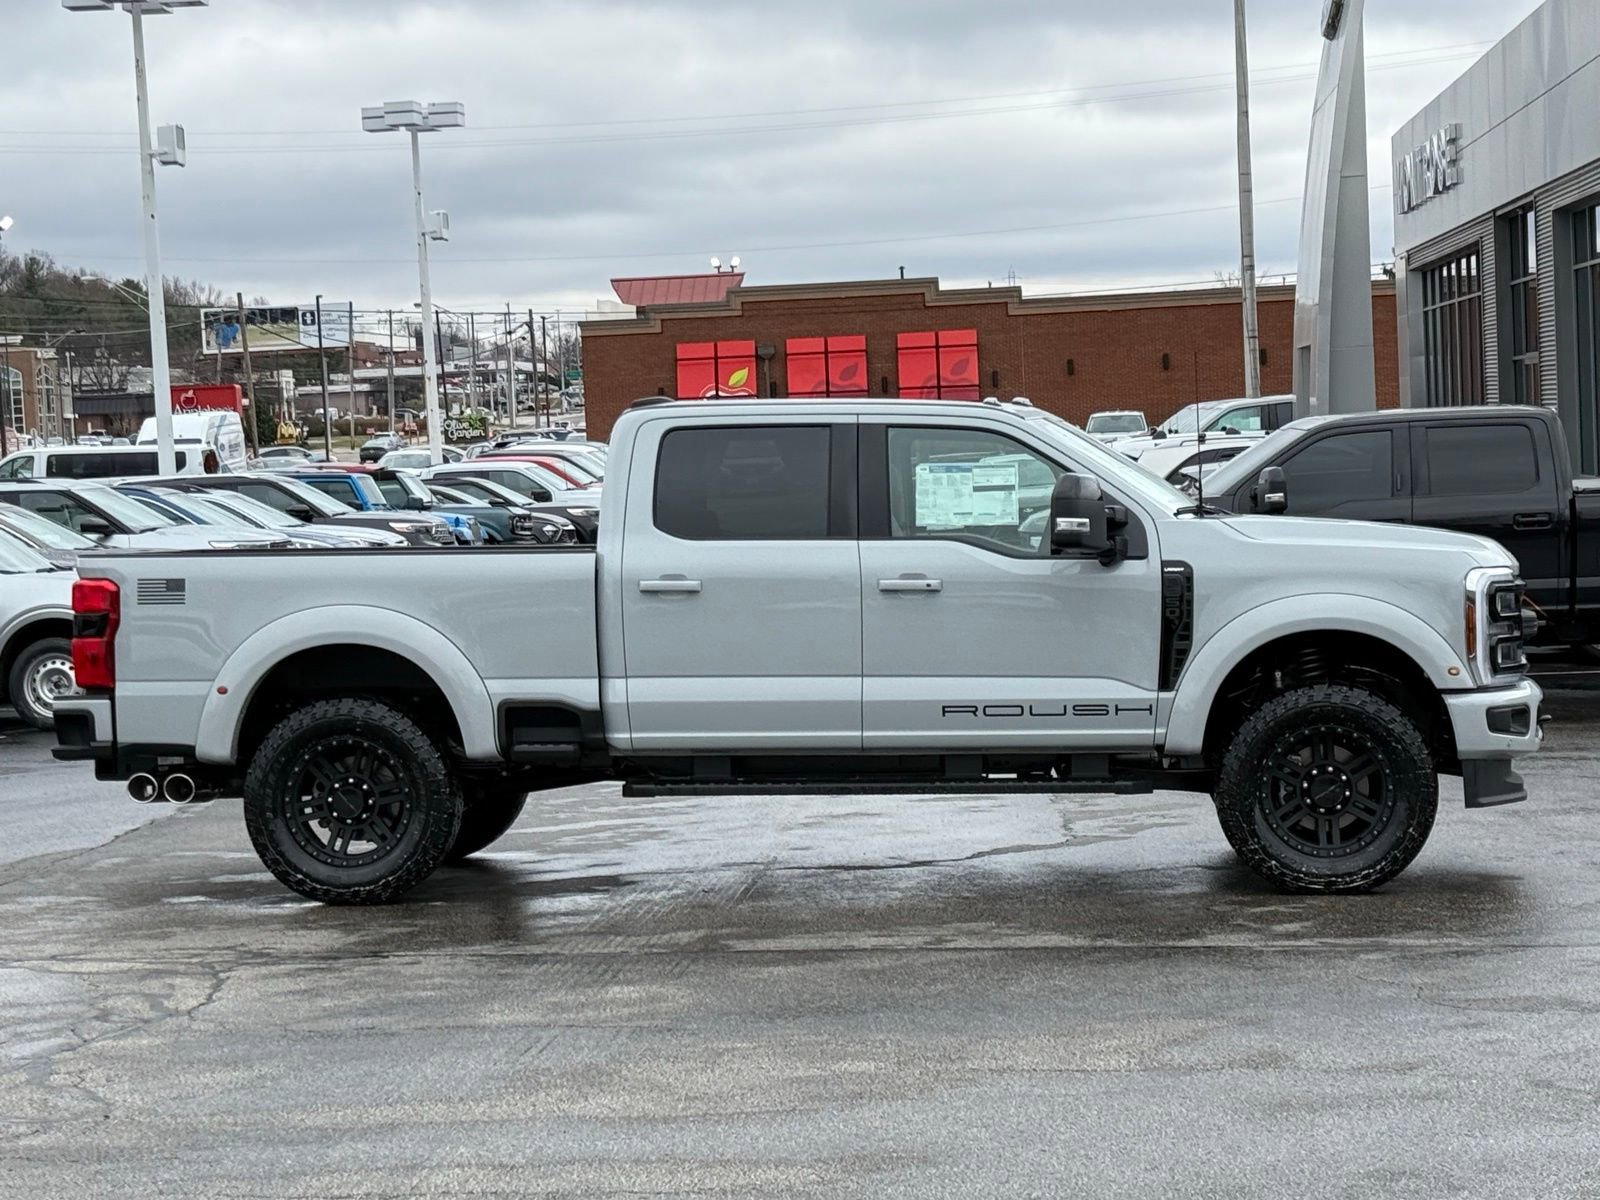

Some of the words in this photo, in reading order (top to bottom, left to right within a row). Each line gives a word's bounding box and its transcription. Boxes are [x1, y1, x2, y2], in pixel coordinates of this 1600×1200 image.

[444, 419, 470, 430] Olive
[448, 427, 486, 441] Garden
[941, 703, 1153, 718] ROUSH
